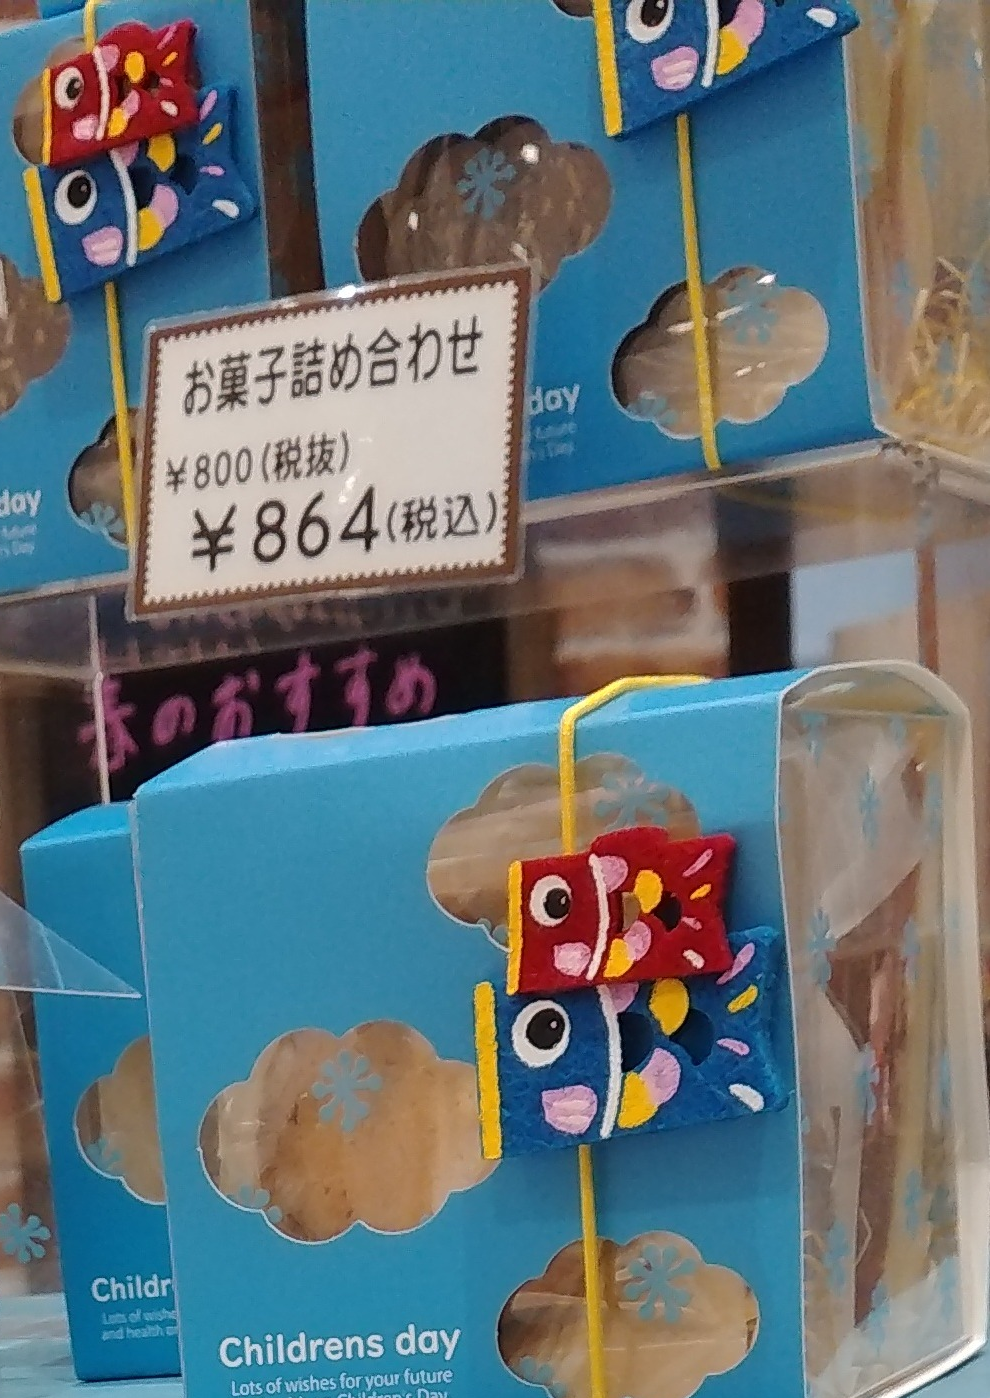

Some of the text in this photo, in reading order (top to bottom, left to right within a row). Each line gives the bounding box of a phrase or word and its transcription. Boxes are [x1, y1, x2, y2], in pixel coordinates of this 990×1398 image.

[183, 314, 484, 417] お菓子詰め合わせ
[166, 430, 350, 494] ¥800(税抜)
[191, 485, 498, 573] ¥864(税込)
[91, 1273, 174, 1302] Childr
[219, 1323, 462, 1369] Childrens day
[231, 1367, 454, 1397] Lots of wishes for your future
